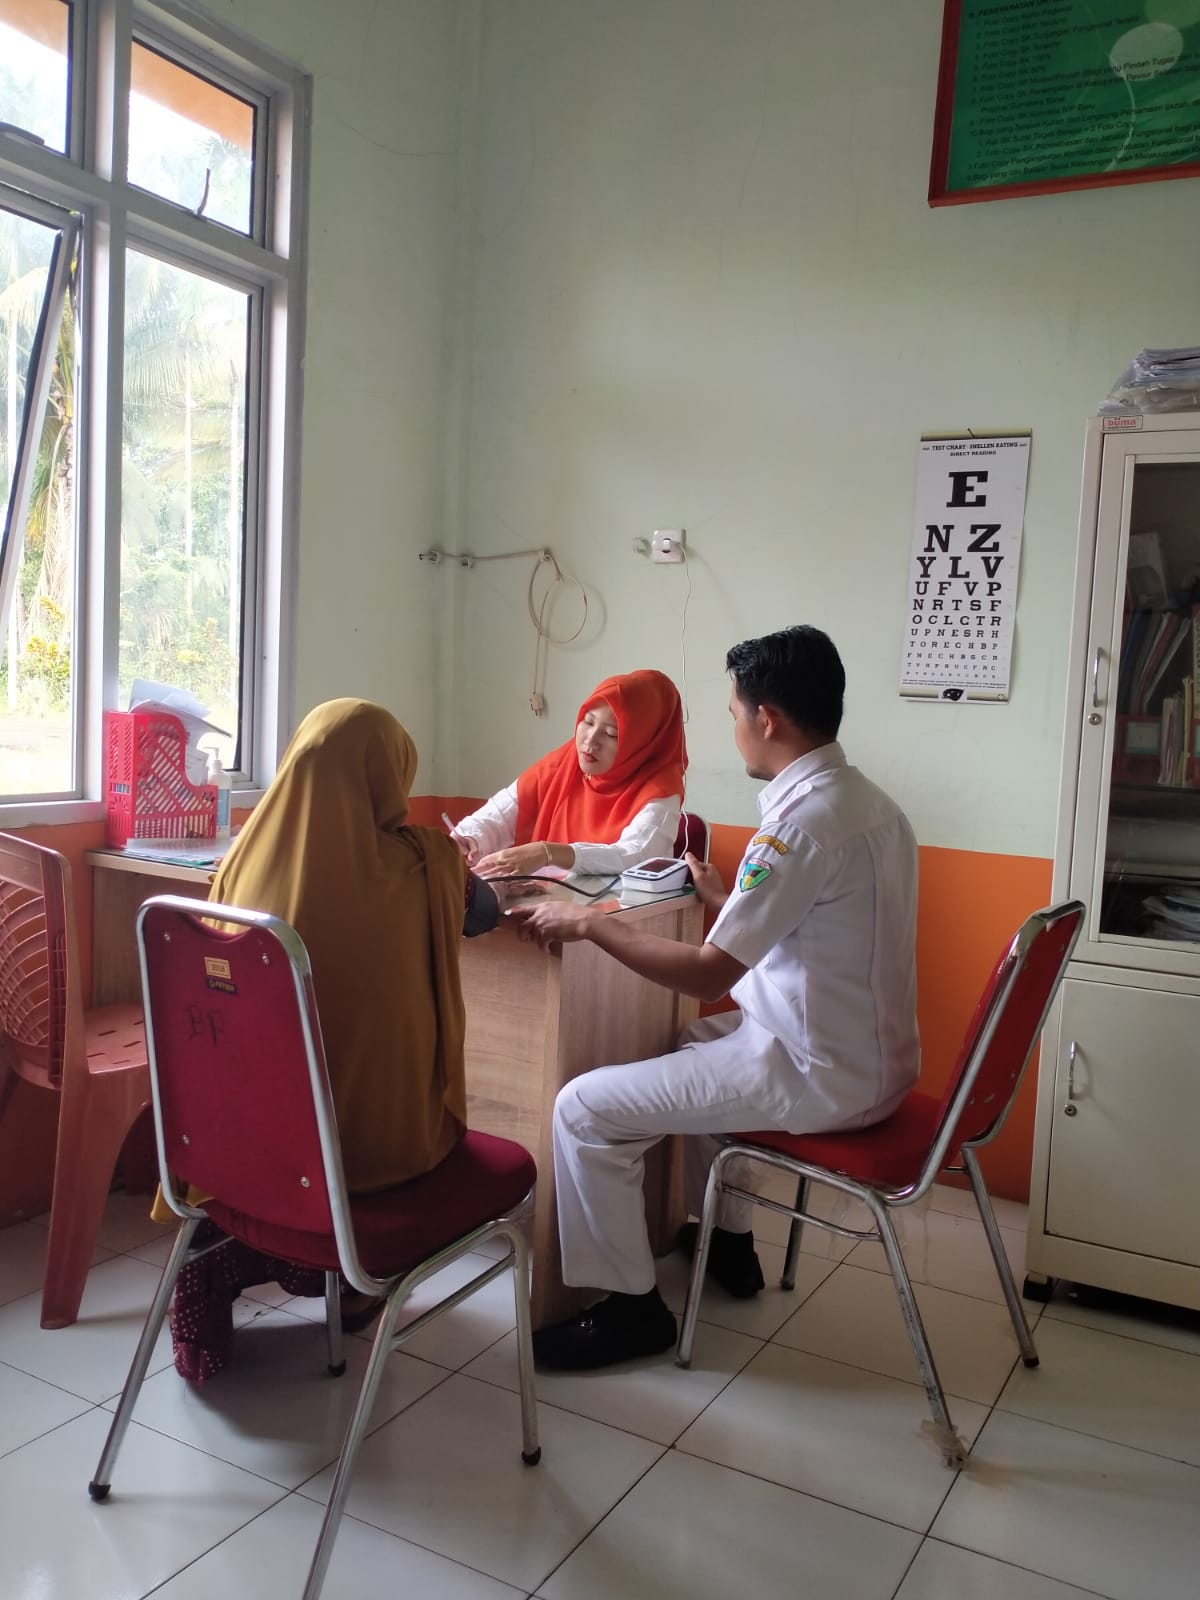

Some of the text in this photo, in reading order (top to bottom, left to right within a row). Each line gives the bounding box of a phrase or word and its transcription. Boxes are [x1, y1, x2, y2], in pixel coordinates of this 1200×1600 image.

[945, 470, 989, 508] E
[923, 523, 1002, 553] N Z
[916, 555, 1005, 579] Y L V
[914, 580, 1002, 597] U F V P
[912, 598, 1002, 612] N R T S F
[912, 614, 1001, 627] O C L C T R
